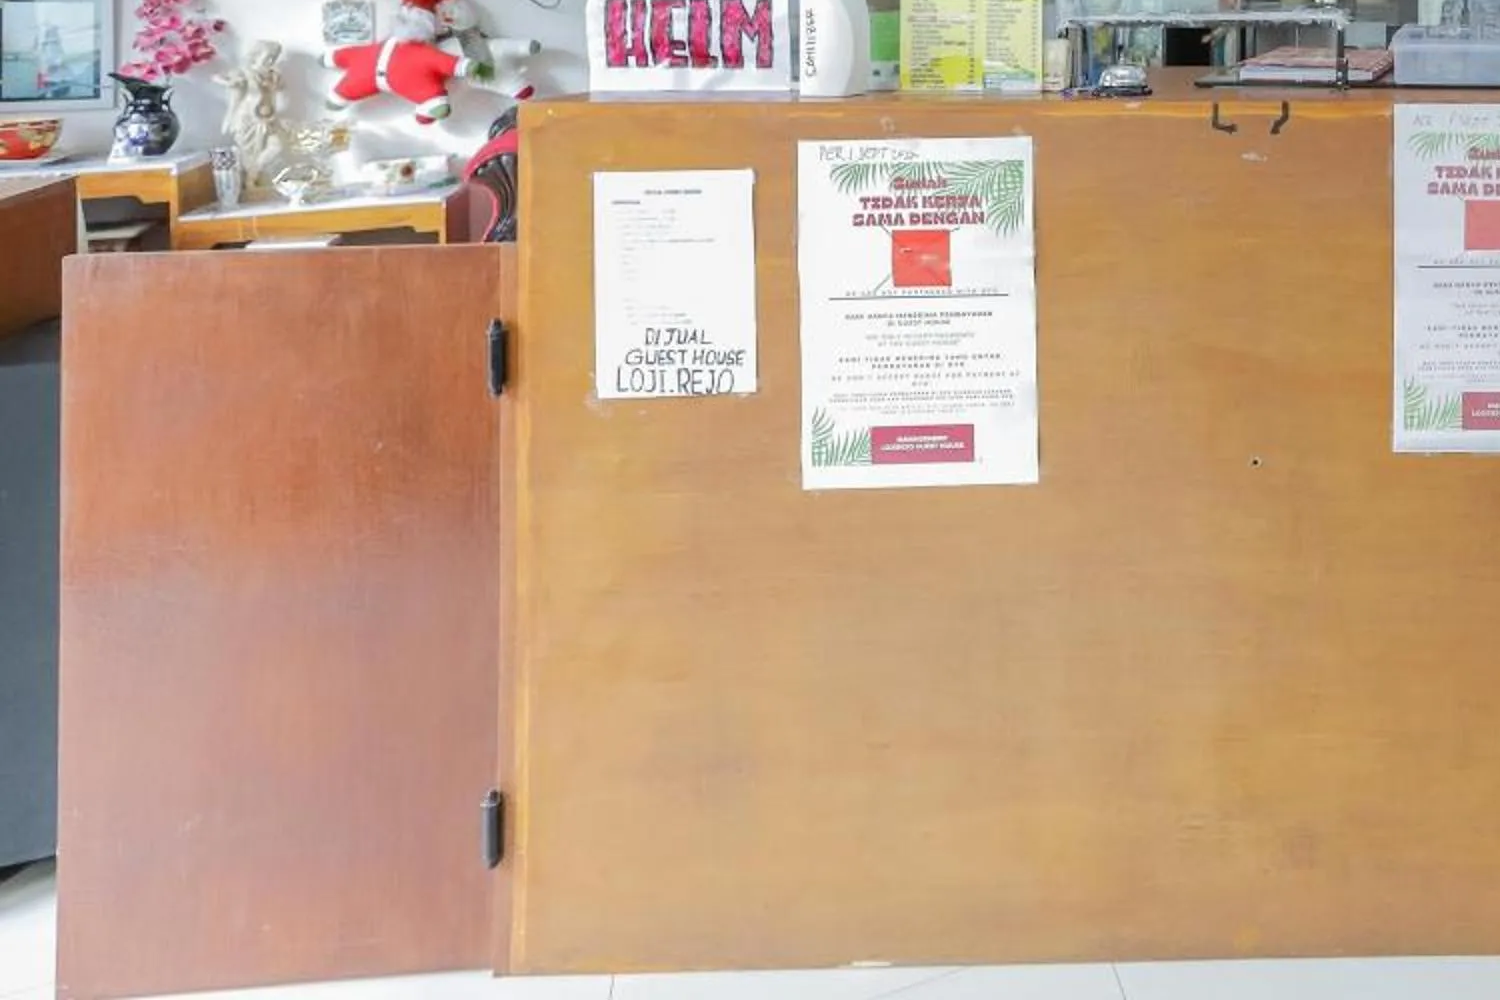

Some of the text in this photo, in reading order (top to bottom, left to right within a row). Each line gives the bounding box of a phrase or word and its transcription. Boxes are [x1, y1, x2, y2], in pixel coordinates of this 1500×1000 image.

[1434, 165, 1492, 179] TIDAK
[1427, 181, 1480, 196] SAMA
[859, 195, 919, 210] TIDAK
[852, 210, 986, 227] SAMA DENGAN
[625, 348, 746, 367] GUEST HOUSE
